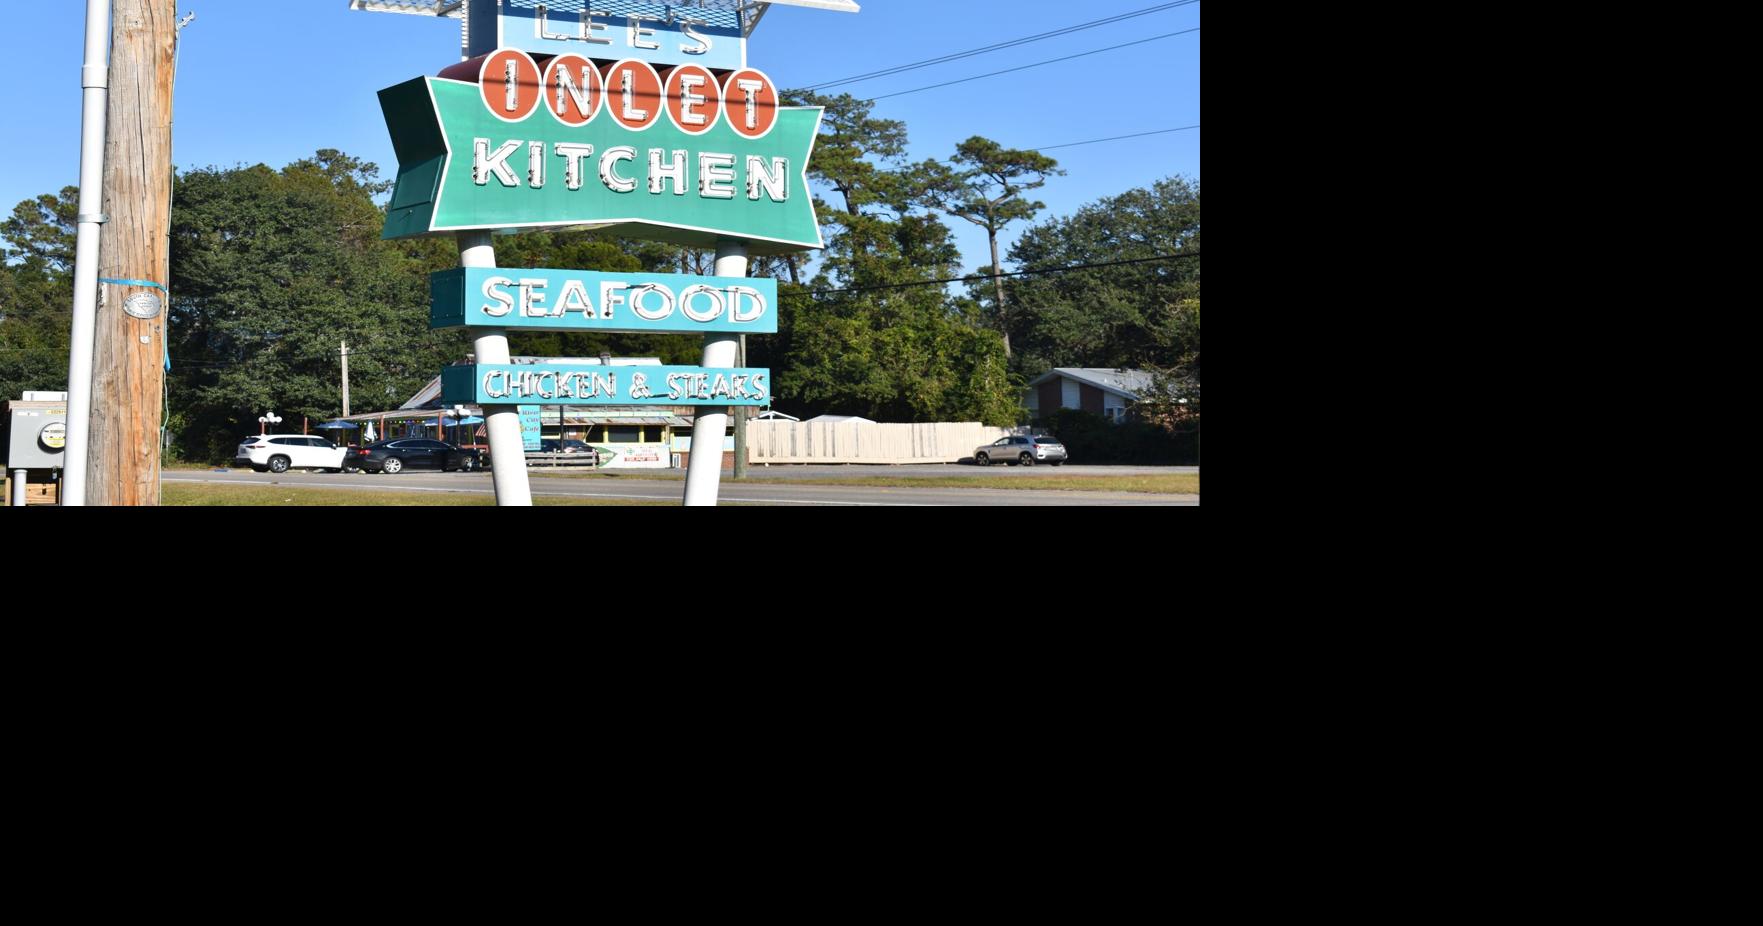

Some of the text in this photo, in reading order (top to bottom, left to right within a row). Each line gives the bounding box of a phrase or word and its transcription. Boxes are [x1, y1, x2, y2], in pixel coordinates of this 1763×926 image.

[534, 5, 713, 55] LEE'S
[504, 59, 766, 130] INLET
[473, 137, 790, 201] KITCHEN
[481, 276, 768, 323] SEAFOOD
[482, 370, 768, 400] CHICKEN & STEAKS
